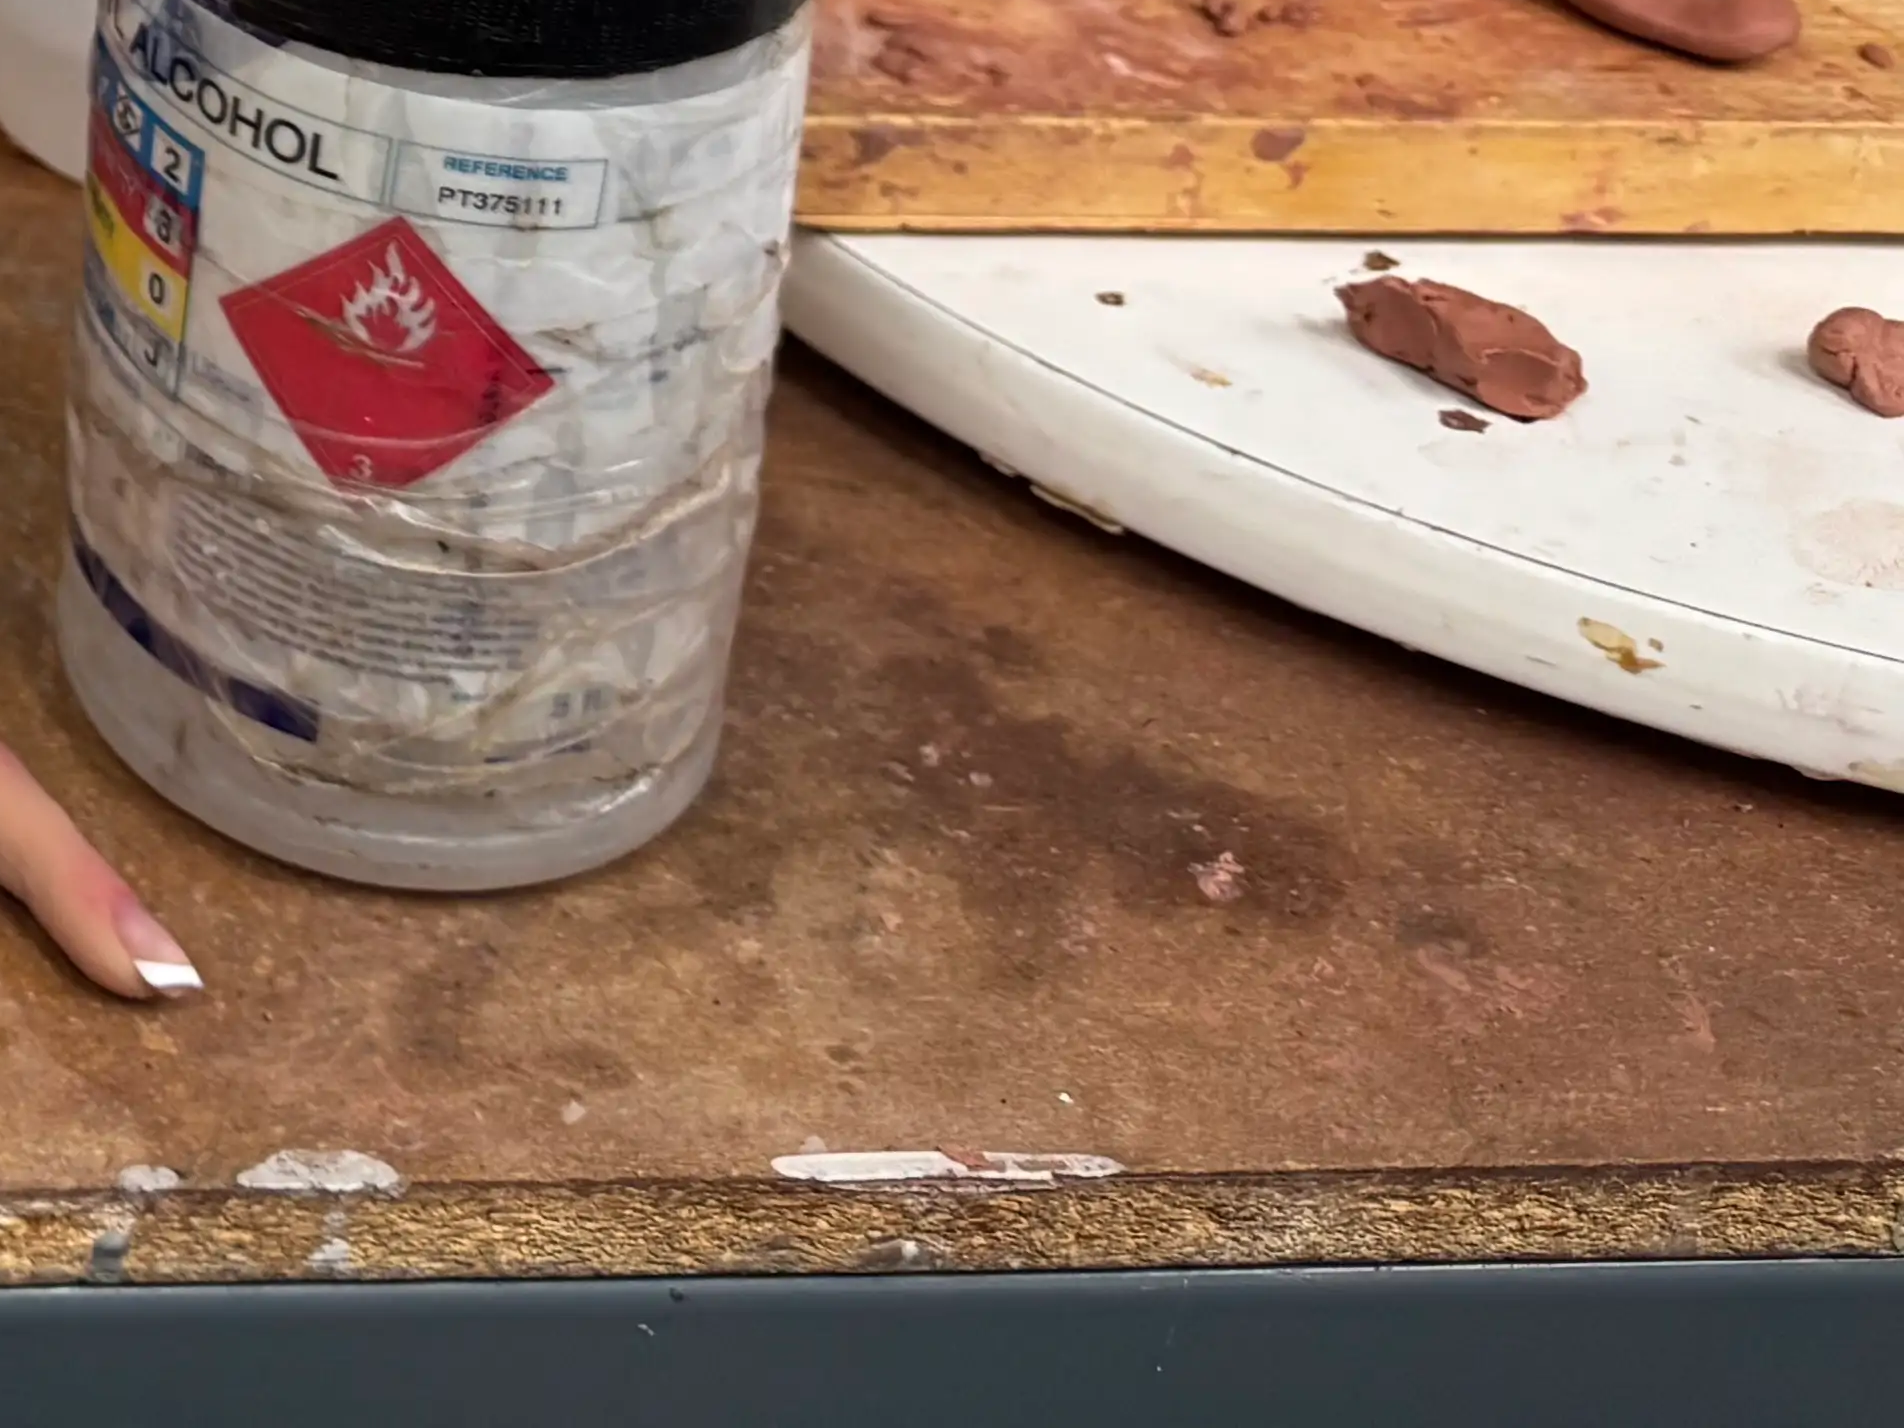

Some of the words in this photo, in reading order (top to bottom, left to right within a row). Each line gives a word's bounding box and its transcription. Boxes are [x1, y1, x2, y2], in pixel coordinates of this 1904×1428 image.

[129, 21, 339, 181] ALCOHOL
[162, 145, 182, 185] 2
[443, 155, 570, 183] REFERENCE
[437, 185, 564, 216] PT375111
